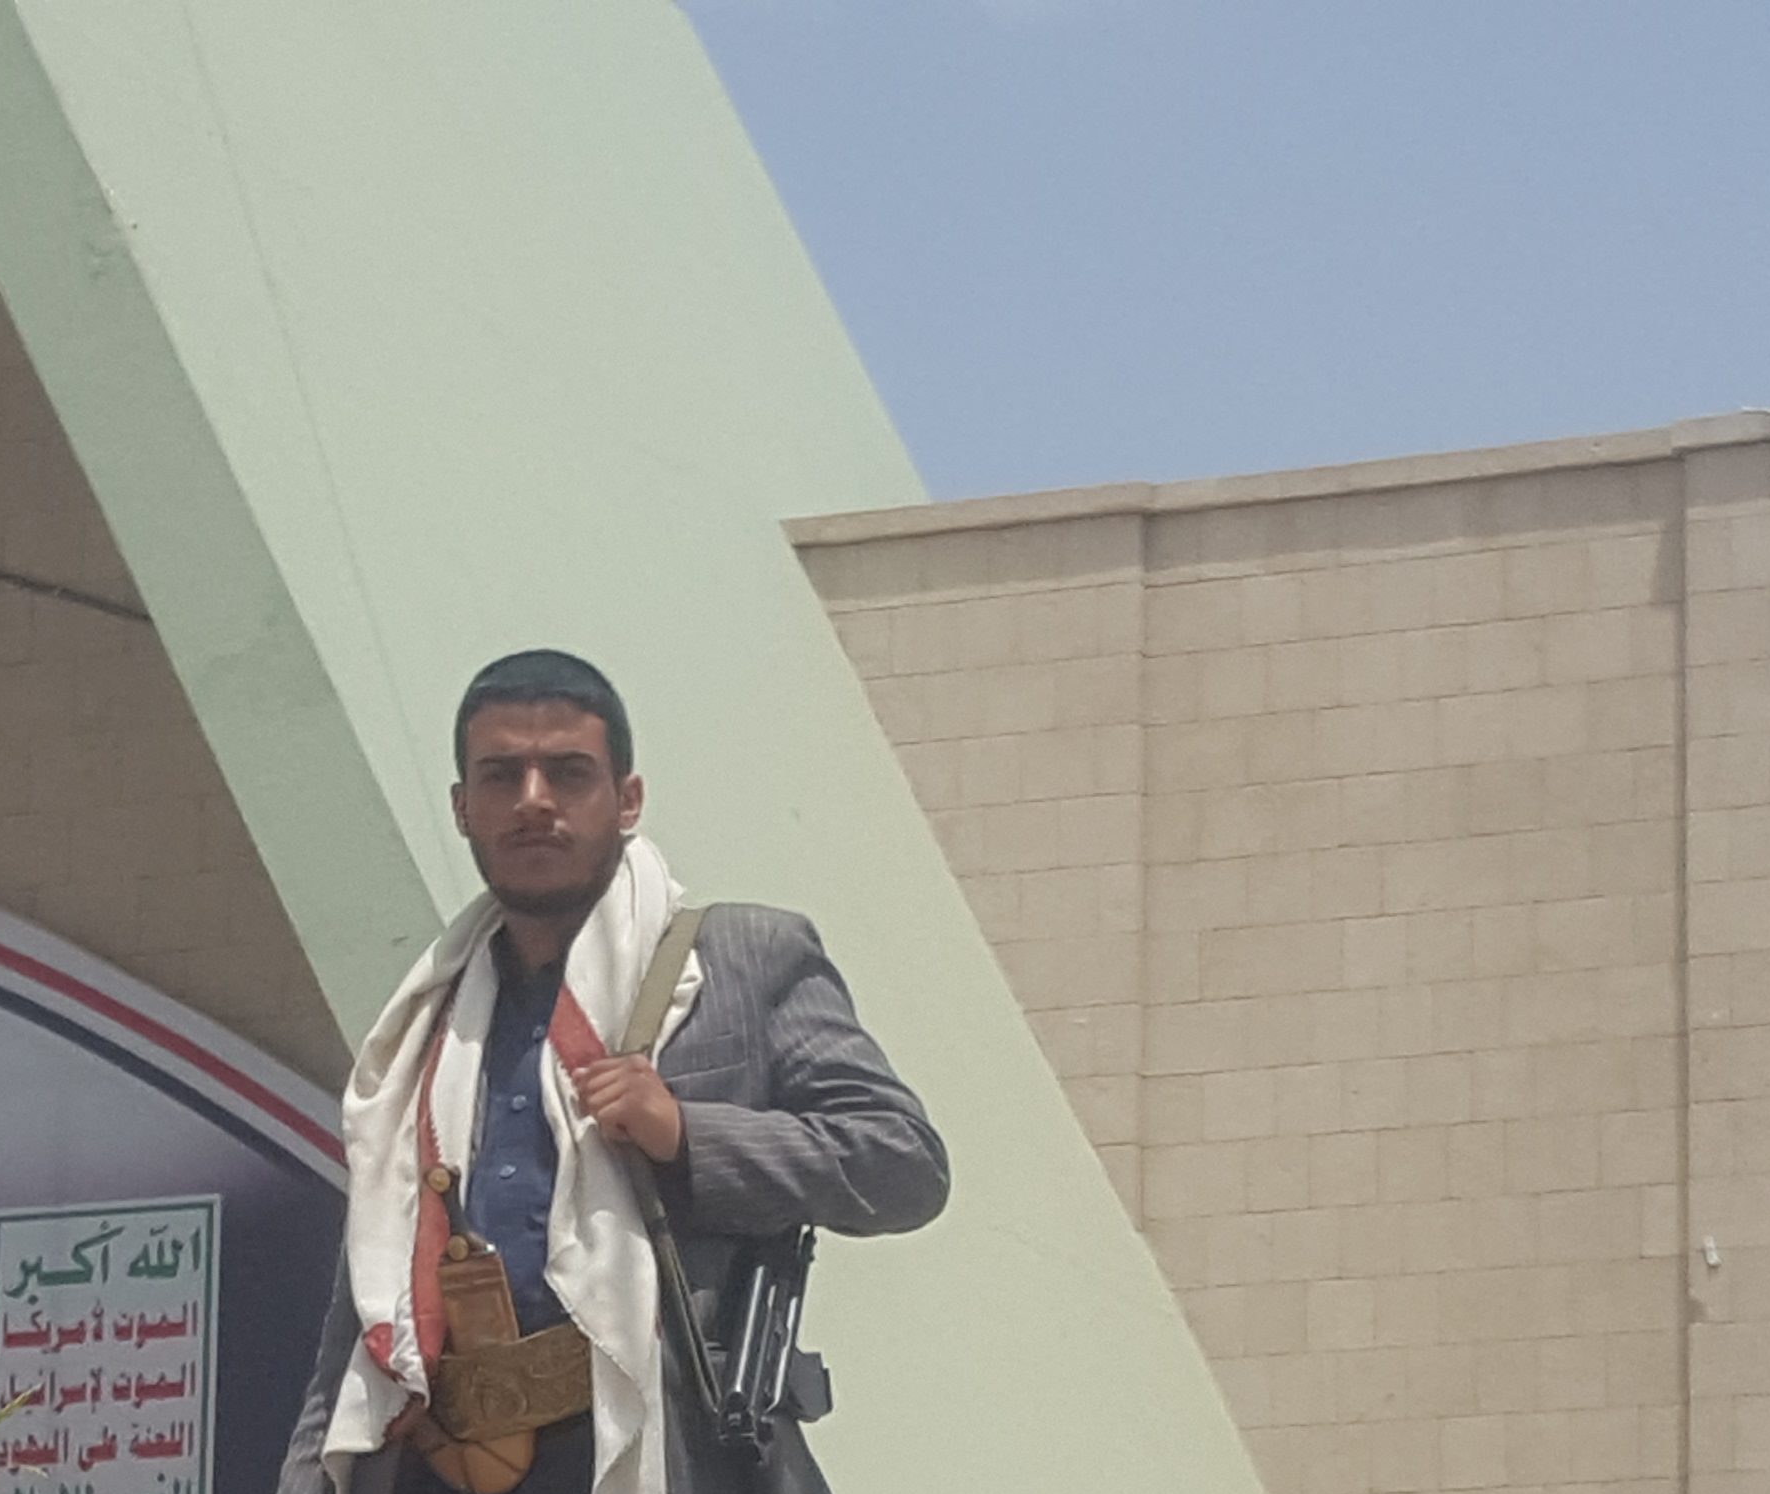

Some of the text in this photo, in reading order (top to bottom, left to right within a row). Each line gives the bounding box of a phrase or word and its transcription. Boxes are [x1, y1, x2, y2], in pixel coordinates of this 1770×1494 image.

[3, 1221, 201, 1304] الله أكبر
[113, 1300, 197, 1349] الموت
[112, 1360, 196, 1408] الموت
[78, 1427, 118, 1472] على
[129, 1420, 194, 1459] اللعنة
